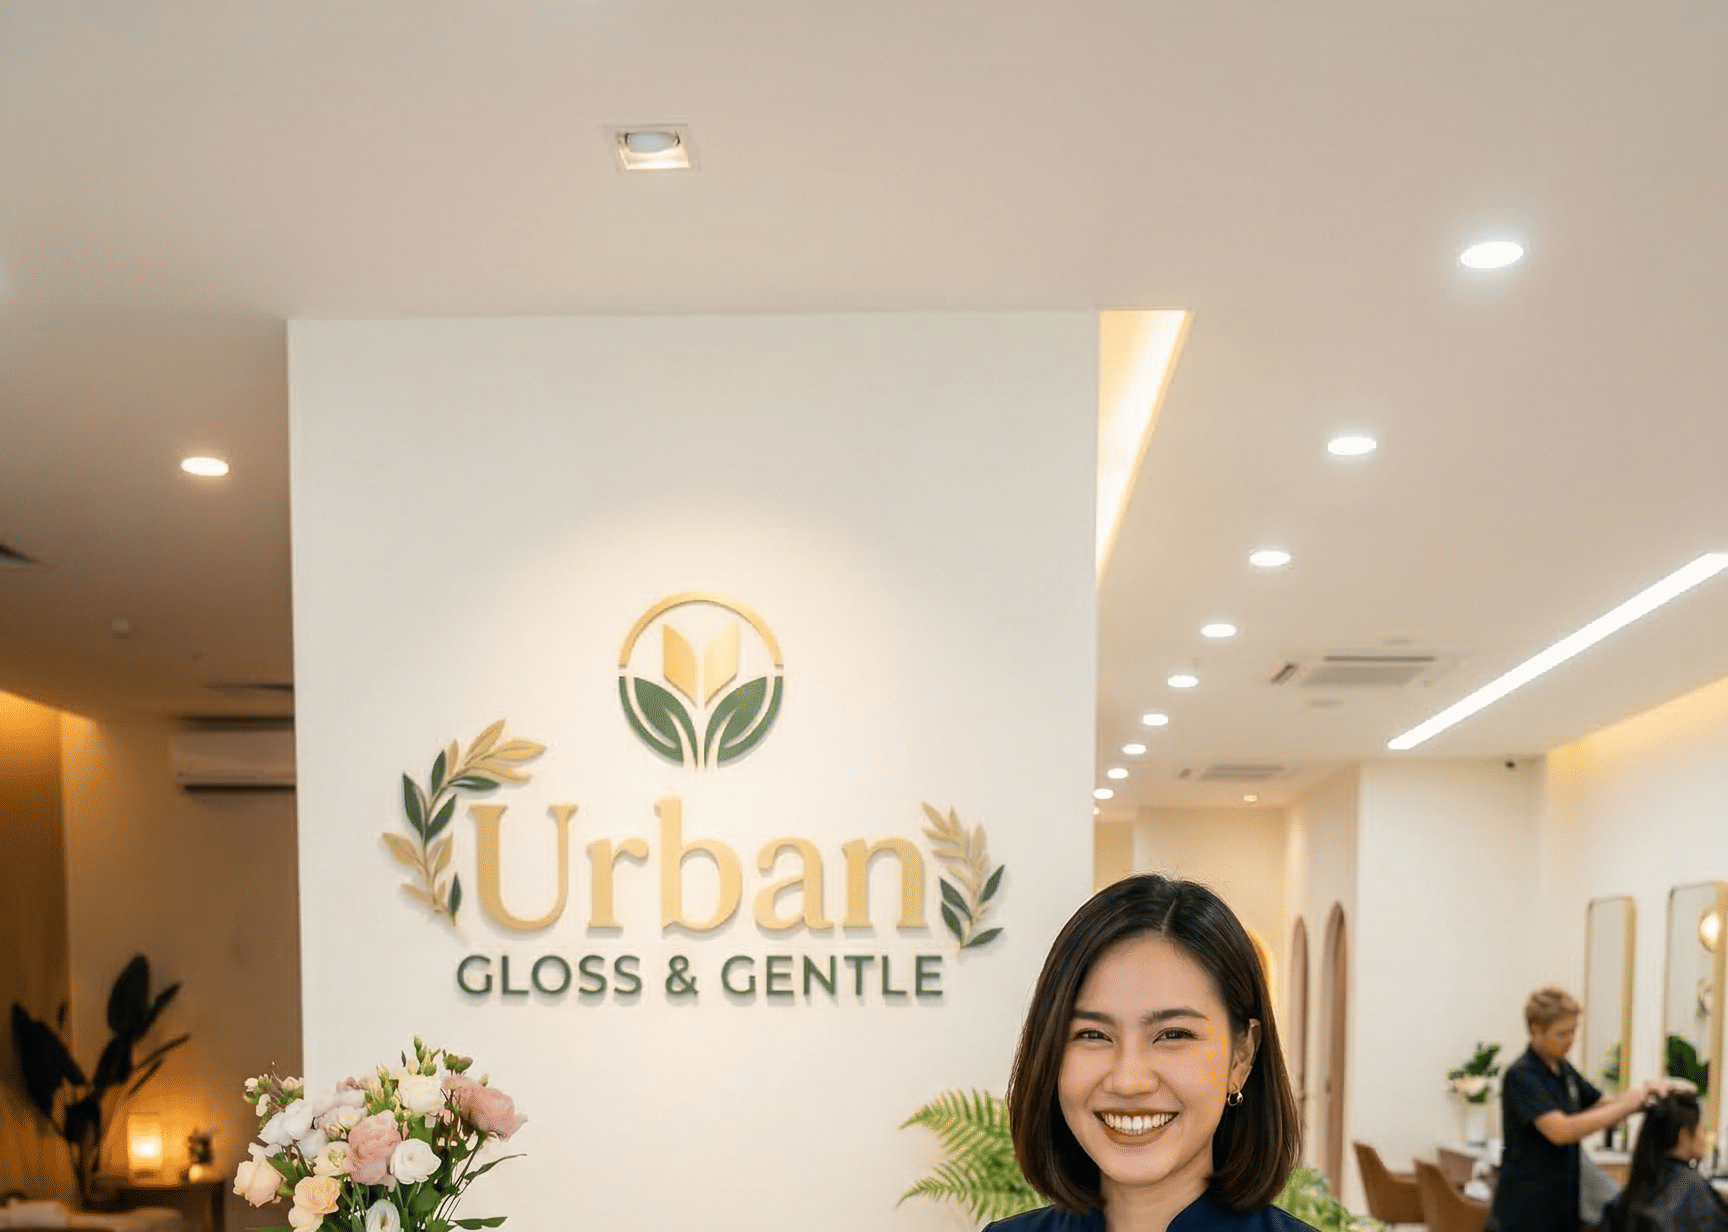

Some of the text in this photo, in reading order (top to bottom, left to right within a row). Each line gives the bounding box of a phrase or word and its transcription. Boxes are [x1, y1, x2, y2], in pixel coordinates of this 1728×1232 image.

[469, 797, 929, 933] Urban
[457, 954, 944, 997] GLOSS & GENTLE
